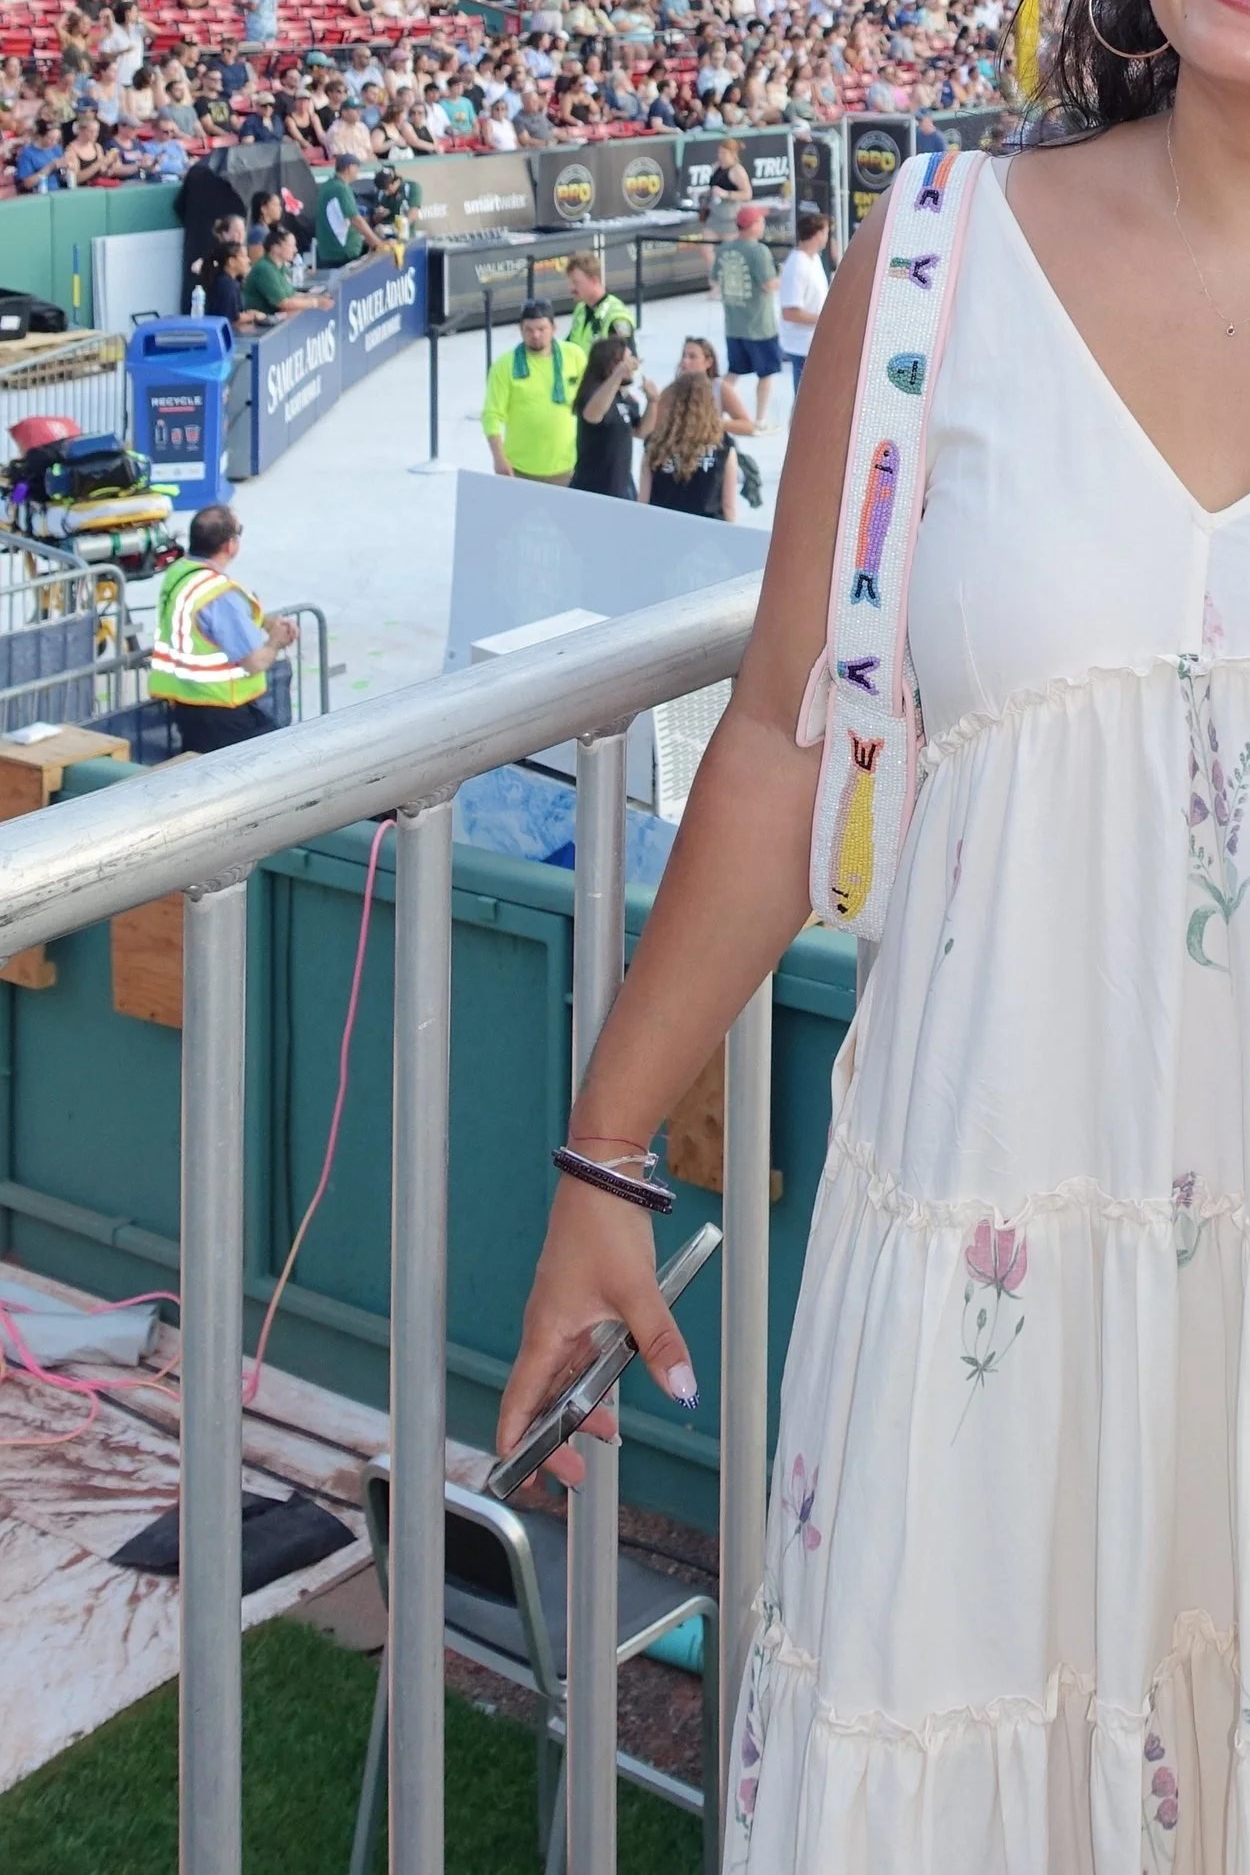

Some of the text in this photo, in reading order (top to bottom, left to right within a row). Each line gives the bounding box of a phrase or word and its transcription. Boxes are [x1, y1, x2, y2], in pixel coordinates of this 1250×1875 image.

[687, 164, 713, 186] TR
[463, 192, 526, 216] smartwater
[348, 288, 384, 343] SAMUEL
[385, 266, 416, 312] ADAMS
[267, 347, 305, 415] SAMUEL
[306, 319, 336, 374] ADAMS
[151, 395, 203, 407] RECYCLE
